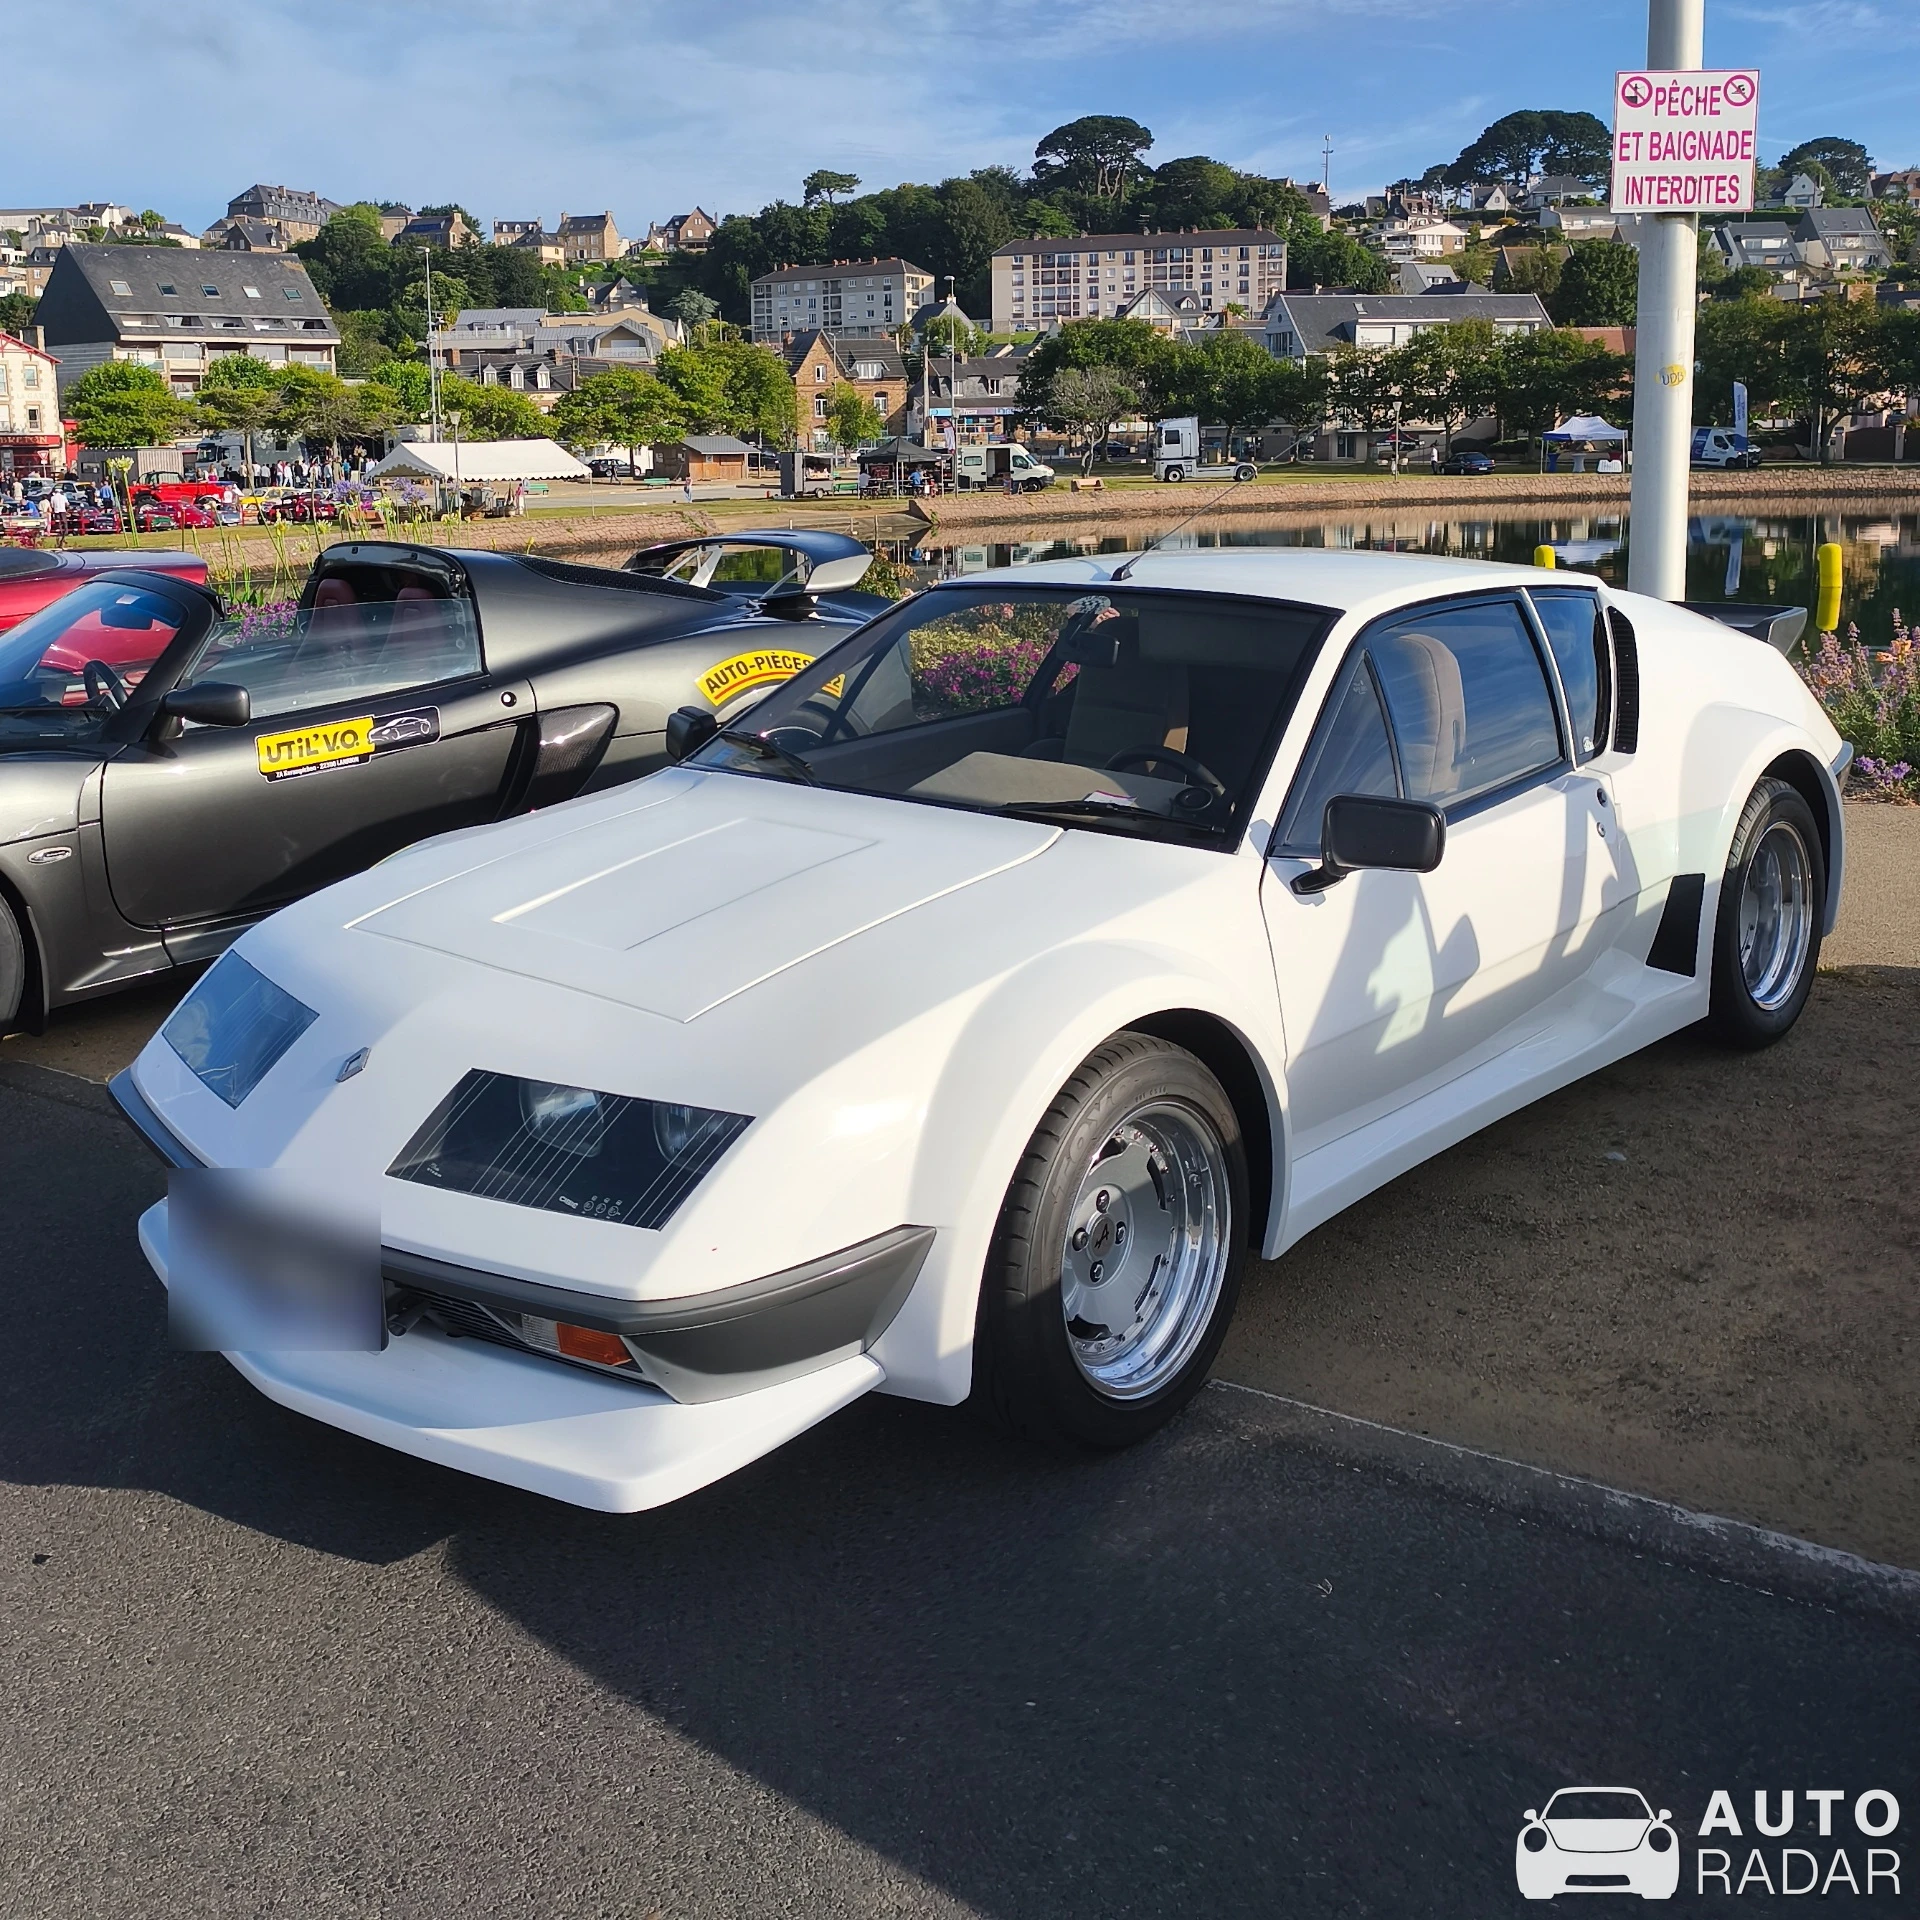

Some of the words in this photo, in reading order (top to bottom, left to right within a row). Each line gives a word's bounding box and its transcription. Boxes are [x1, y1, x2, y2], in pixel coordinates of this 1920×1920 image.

[1654, 79, 1721, 116] PÊCHE
[1619, 131, 1644, 162] ET
[1649, 130, 1753, 161] BAIGNADE
[1625, 174, 1740, 205] INTERDITES
[0, 436, 47, 444] BRETON
